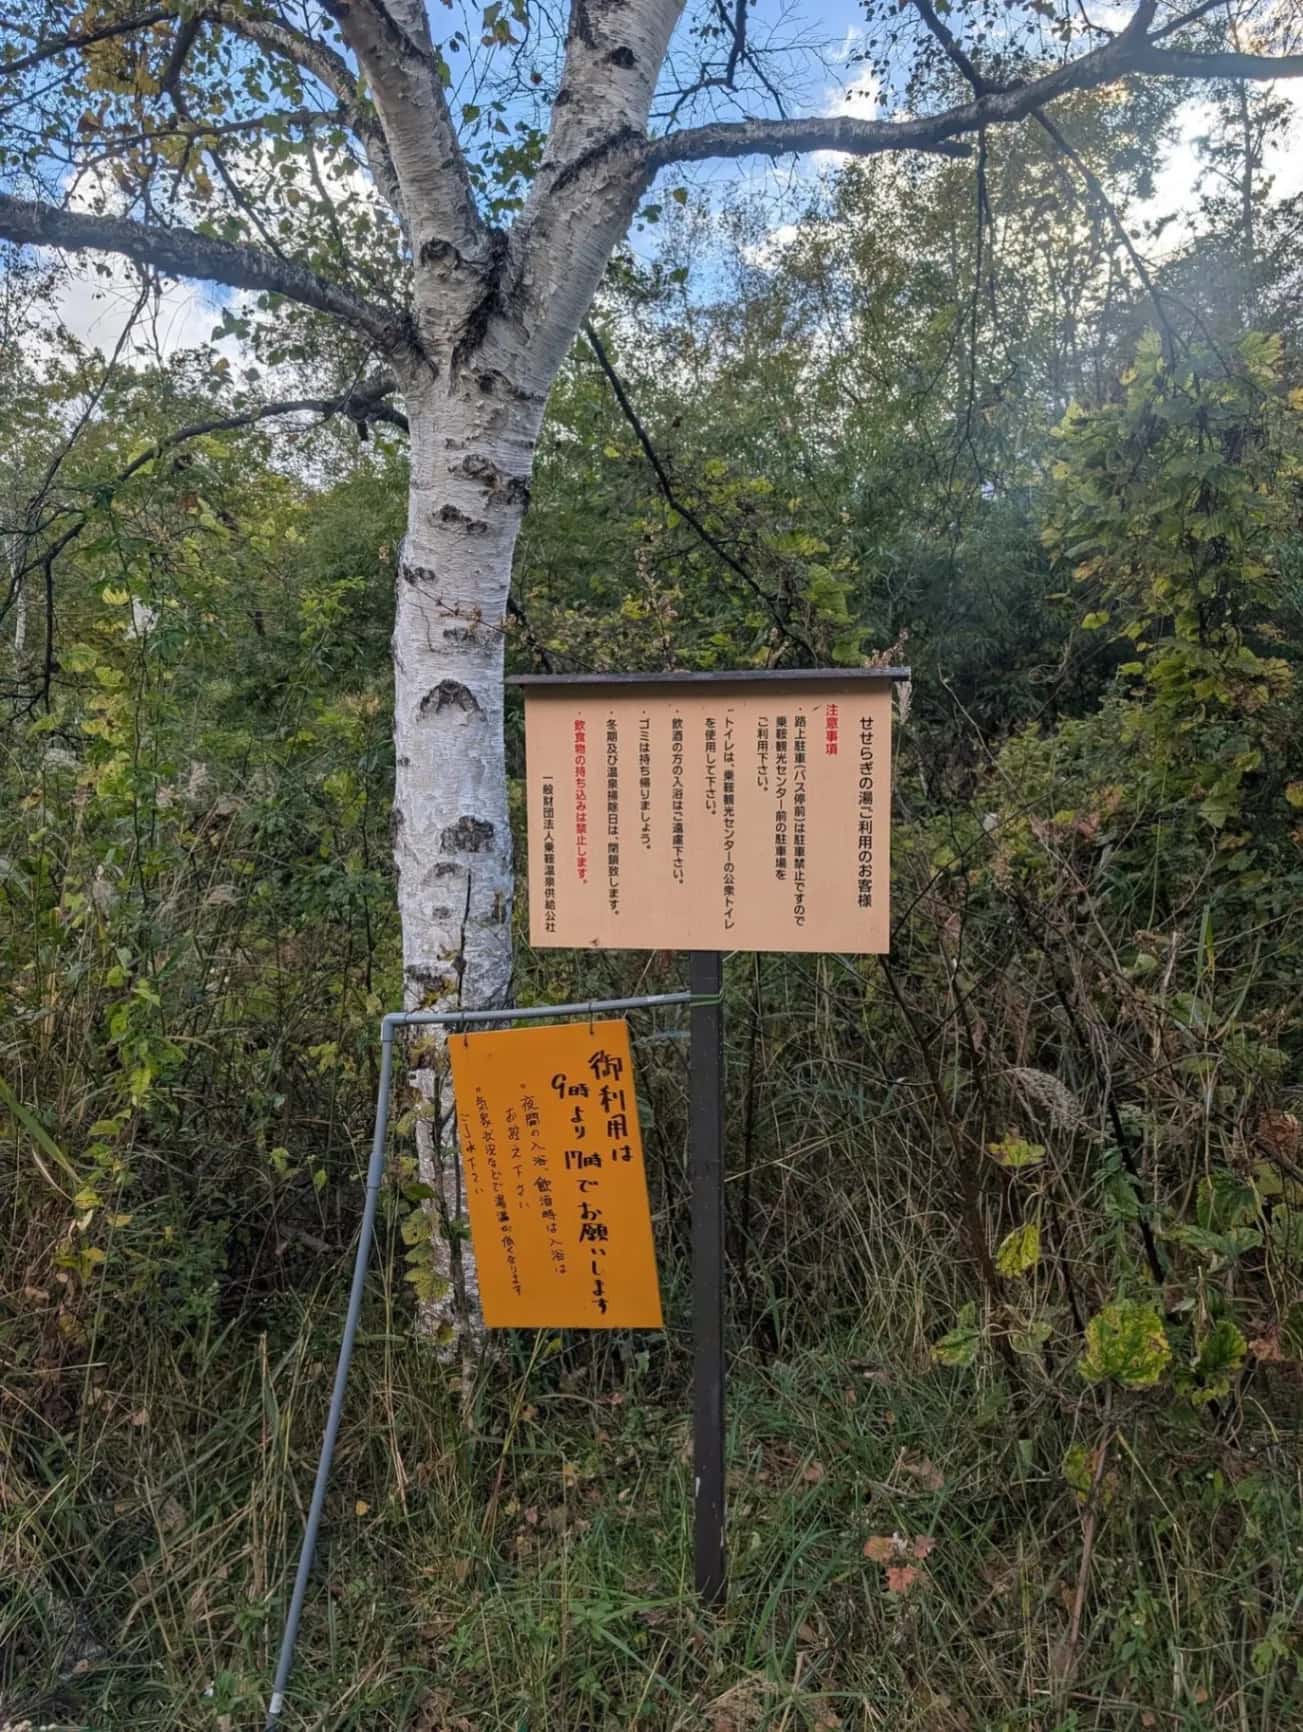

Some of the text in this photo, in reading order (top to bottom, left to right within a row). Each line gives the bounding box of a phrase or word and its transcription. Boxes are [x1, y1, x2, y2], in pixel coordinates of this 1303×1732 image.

[705, 718, 717, 815] を使用して下さい。
[757, 717, 769, 792] ご利用下さい。
[825, 704, 839, 756] 注意事項
[542, 776, 556, 933] 一般財団法人乗鞍温泉供給公社
[775, 716, 787, 881] 乗鞍観光センター前の駐車場を
[858, 716, 874, 908] せせらぎの湯ご利用のお客様
[588, 1050, 634, 1163] 御利用は
